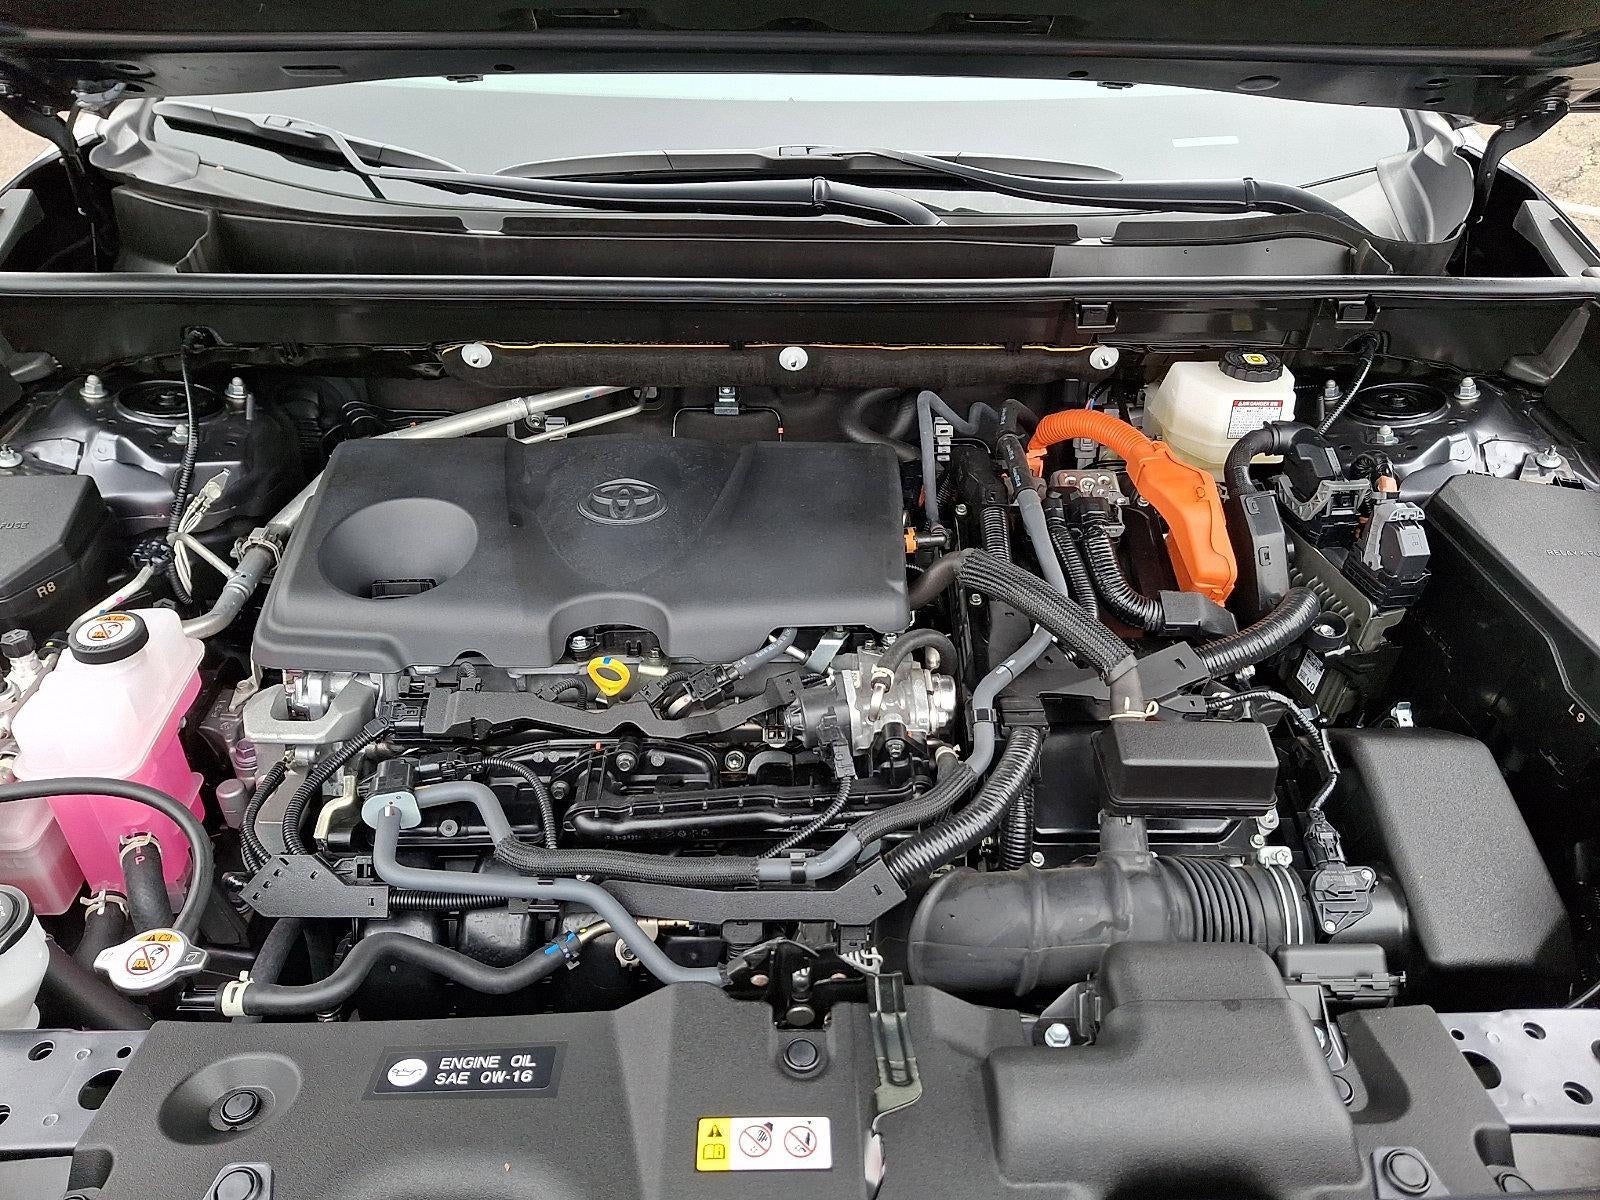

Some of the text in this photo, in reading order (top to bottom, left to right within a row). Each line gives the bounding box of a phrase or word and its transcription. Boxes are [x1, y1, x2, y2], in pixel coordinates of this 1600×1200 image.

[0, 521, 30, 530] FUSE
[36, 581, 56, 598] R8
[1568, 703, 1586, 723] L9
[134, 855, 146, 865] P
[438, 1054, 537, 1070] ENGINE OIL
[434, 1071, 471, 1086] SAE
